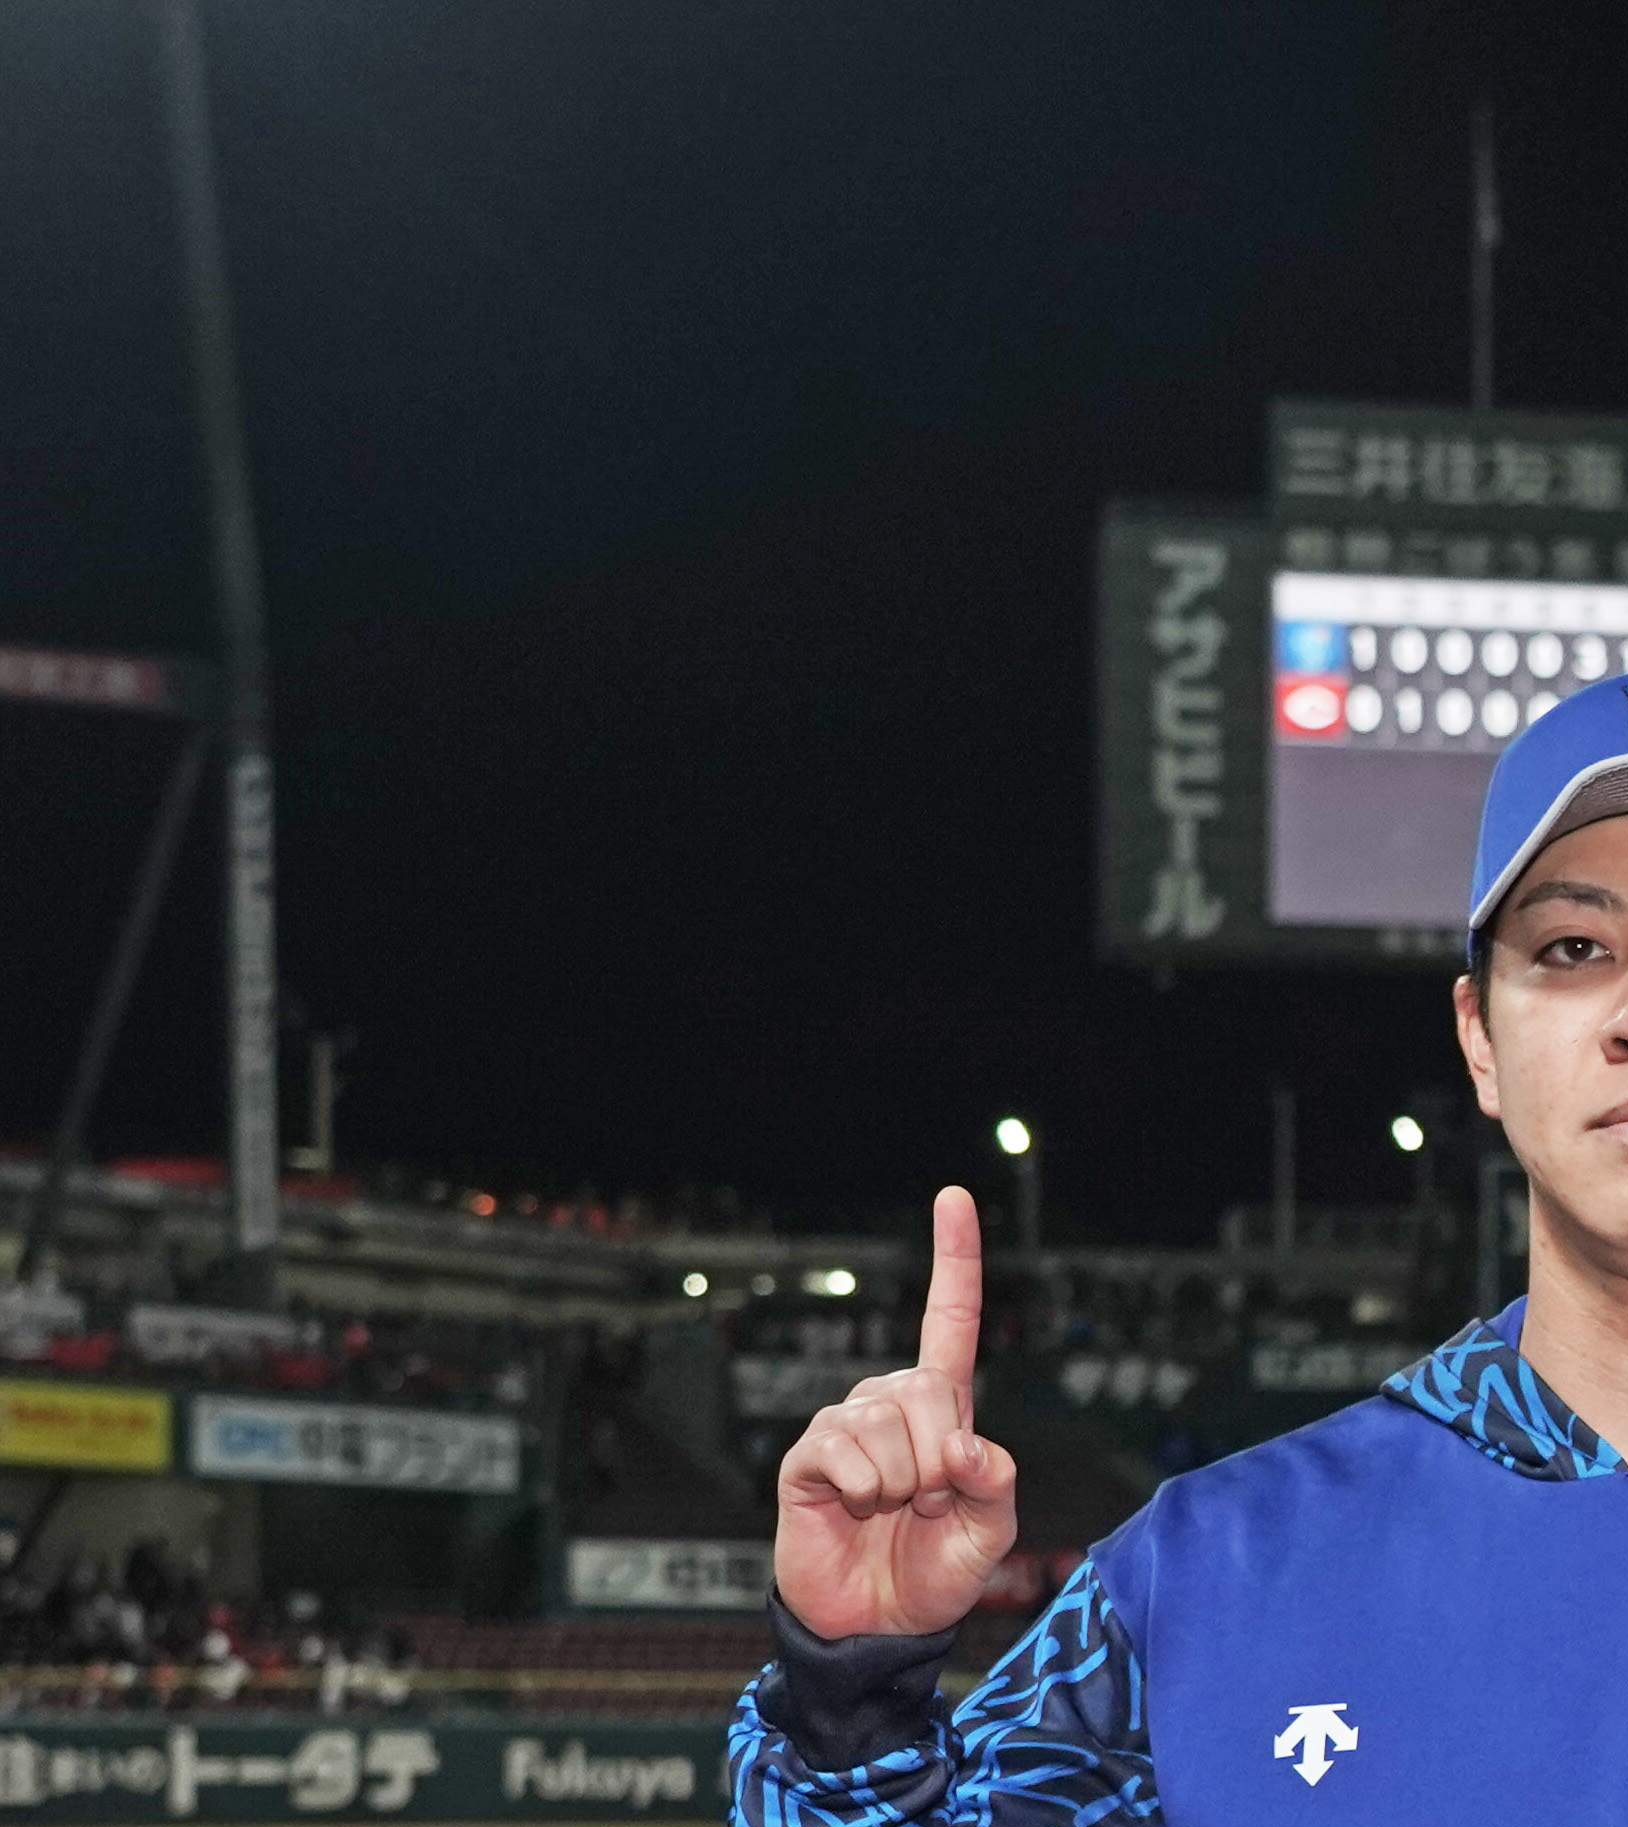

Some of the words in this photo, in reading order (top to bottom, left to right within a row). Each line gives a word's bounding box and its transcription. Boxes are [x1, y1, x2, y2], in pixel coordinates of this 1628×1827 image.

[1144, 540, 1230, 940] アサヒビール
[504, 1737, 696, 1807] Fukuya
